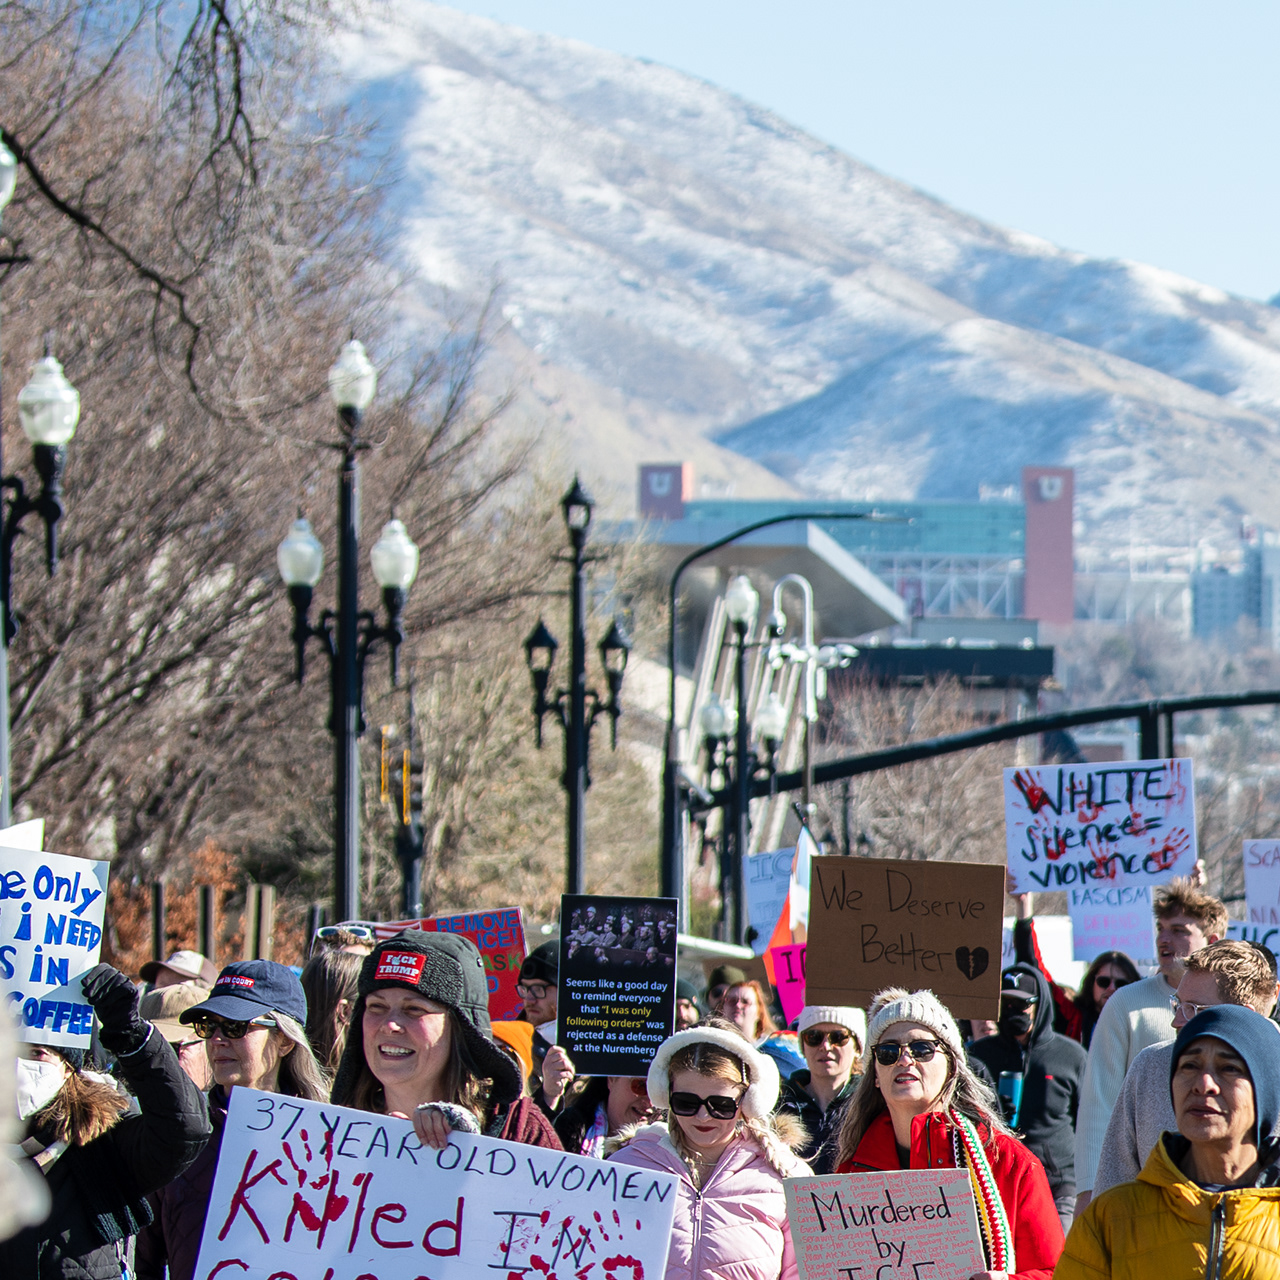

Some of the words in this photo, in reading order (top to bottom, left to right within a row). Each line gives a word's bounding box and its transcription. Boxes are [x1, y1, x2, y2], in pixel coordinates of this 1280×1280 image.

[1014, 766, 1176, 815] WHITE
[33, 865, 102, 917] Only
[817, 865, 863, 911] We
[886, 867, 985, 919] Deserve
[1072, 886, 1150, 906] FASCISM
[44, 912, 101, 952] NEED
[436, 910, 520, 933] REMOVE
[477, 927, 518, 950] ICE!
[861, 924, 952, 972] Better
[379, 965, 420, 977] TRUMP
[386, 954, 418, 966] FCK
[482, 953, 522, 971] ASK
[566, 978, 596, 988] Seems
[598, 980, 615, 988] like
[625, 981, 648, 991] good
[650, 981, 668, 992] day
[572, 992, 582, 1000] to
[583, 993, 616, 1001] remind
[619, 995, 661, 1004] everyone
[566, 1017, 608, 1028] following
[581, 1005, 599, 1014] that
[631, 1007, 652, 1018] only
[566, 1030, 604, 1040] rejected
[627, 1032, 663, 1042] defense
[573, 1044, 582, 1052] at
[585, 1044, 600, 1052] the
[602, 1045, 656, 1055] Nuremberg
[246, 1097, 304, 1141] 37
[318, 1111, 419, 1166] YEAR
[436, 1141, 516, 1176] OLD
[526, 1155, 672, 1203] WOMEN
[218, 1149, 465, 1257] Killed
[487, 1209, 592, 1272] IN
[810, 1186, 951, 1233] Murdered
[871, 1228, 905, 1267] by
